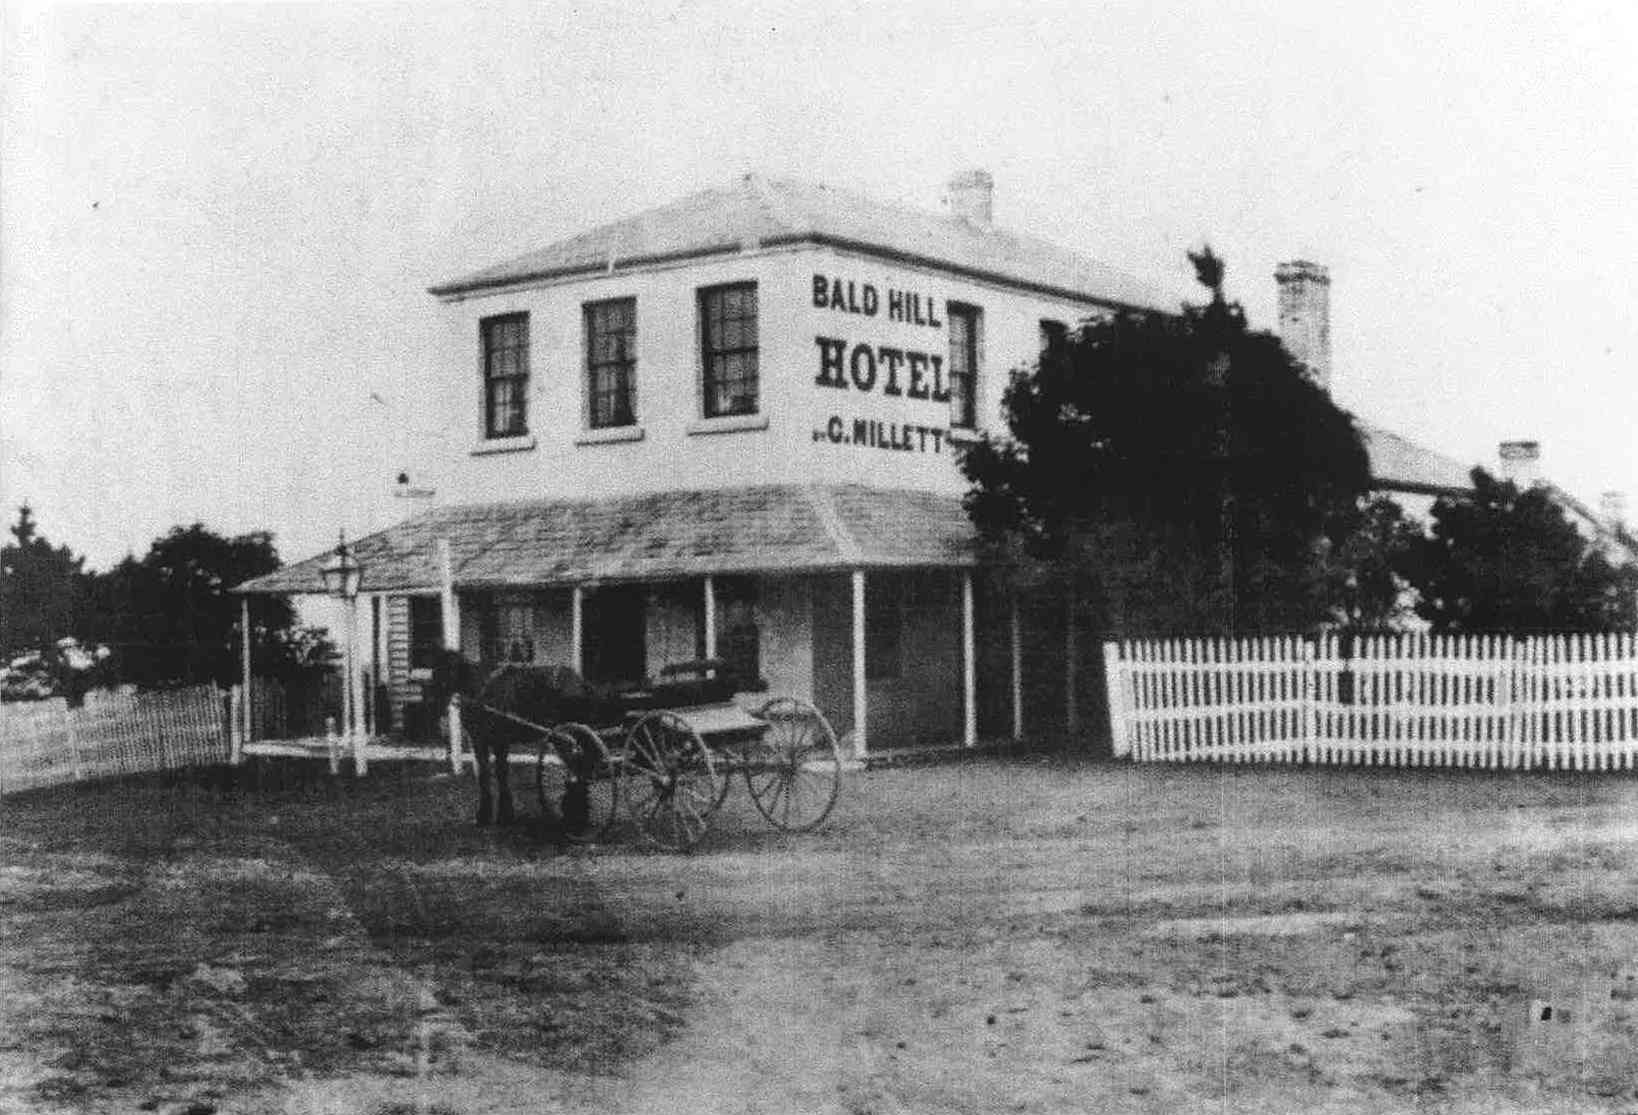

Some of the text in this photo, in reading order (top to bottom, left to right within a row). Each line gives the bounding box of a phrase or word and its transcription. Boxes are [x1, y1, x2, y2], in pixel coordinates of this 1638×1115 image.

[812, 274, 942, 328] BALD HILL
[814, 335, 951, 402] HOTEL
